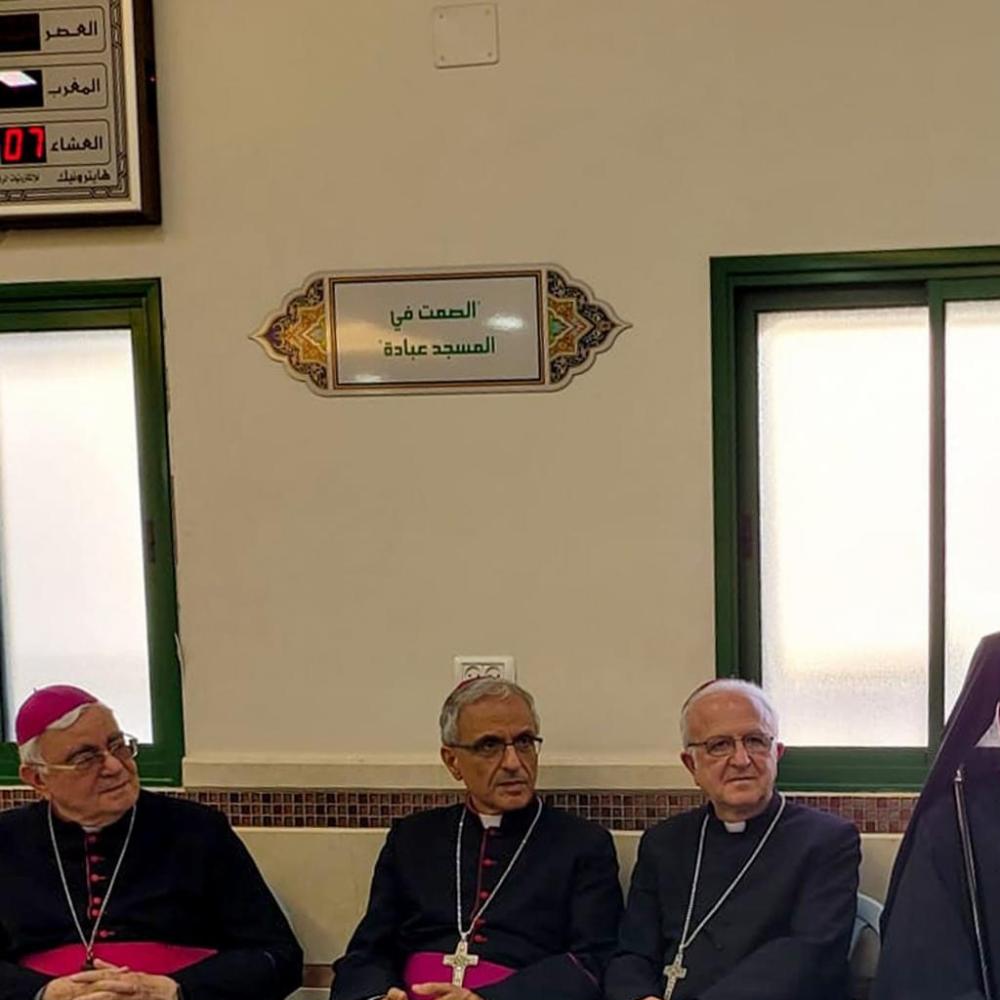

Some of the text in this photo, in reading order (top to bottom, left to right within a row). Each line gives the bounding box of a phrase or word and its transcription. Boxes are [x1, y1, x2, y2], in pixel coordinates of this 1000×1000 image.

[45, 21, 97, 41] العصر
[48, 77, 100, 98] المغرب
[51, 136, 103, 151] العشاء
[390, 305, 413, 331] في
[432, 336, 495, 359] المسجد
